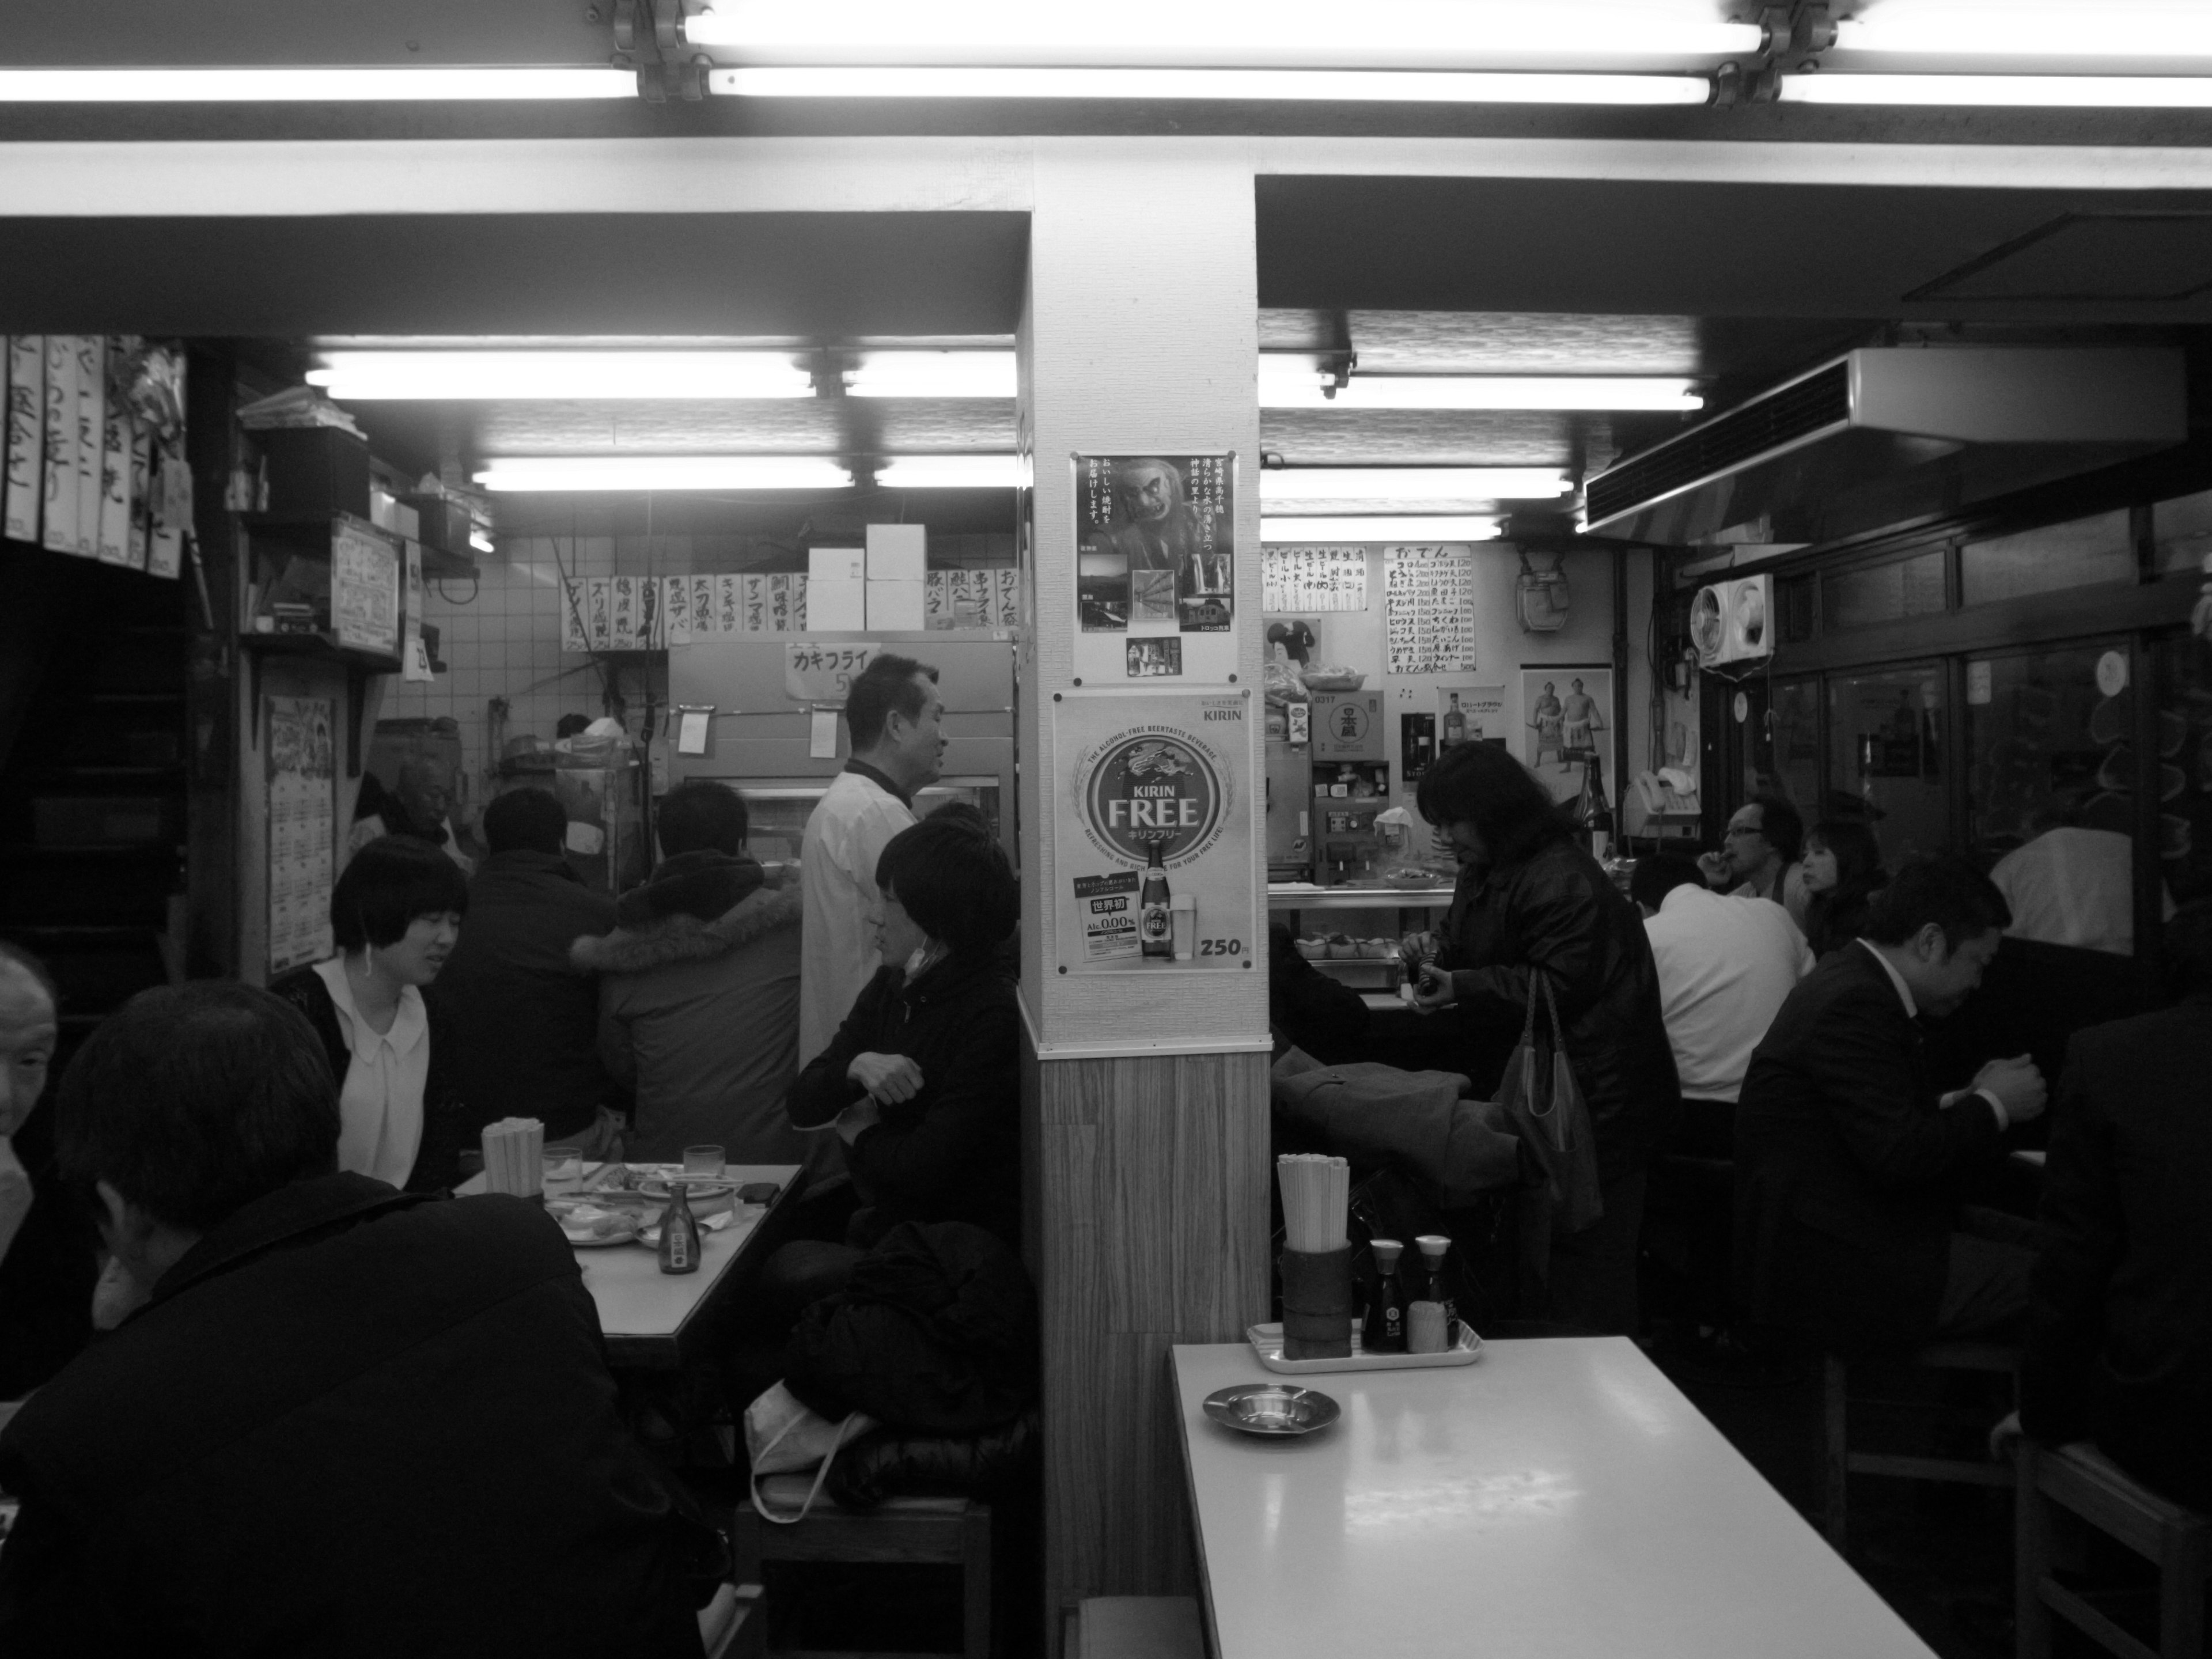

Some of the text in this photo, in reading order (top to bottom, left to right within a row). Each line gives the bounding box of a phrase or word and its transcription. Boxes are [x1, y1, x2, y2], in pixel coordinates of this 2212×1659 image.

[1089, 458, 1099, 524] お届けします。
[1101, 458, 1112, 524] おいしい焼酎を
[1190, 458, 1200, 514] 神話の里より
[1214, 458, 1224, 514] 宮崎県高千穂
[1202, 458, 1213, 551] 清らかな水の湧き立つ
[1396, 546, 1448, 559] おでん
[1457, 559, 1472, 567] 120
[950, 571, 969, 599] 鮭ハ
[1459, 578, 1472, 586] 120
[1459, 588, 1473, 596] 120
[1460, 597, 1473, 605] 100
[1460, 607, 1473, 615] 100
[1432, 616, 1459, 624] ちくわ
[1418, 626, 1431, 634] 150
[1461, 635, 1474, 643] 100
[794, 650, 868, 672] カキフライ
[1315, 695, 1335, 703] 0317
[1203, 710, 1241, 721] KIRIN
[1088, 751, 1099, 764] THE
[1099, 726, 1145, 752] ALCOHOL-FREE
[1147, 725, 1186, 738] BEERTASTE
[1134, 786, 1175, 797] KIRIN
[1108, 798, 1200, 828] FREE
[1128, 831, 1182, 840] キリンフリー
[1084, 828, 1114, 861] REFRESHING
[1115, 858, 1128, 868] AND
[1130, 863, 1146, 872] RICH
[1169, 862, 1182, 870] FOR
[1183, 854, 1200, 866] YOUR
[1199, 840, 1214, 855] FREE
[1093, 899, 1125, 912] 世界初
